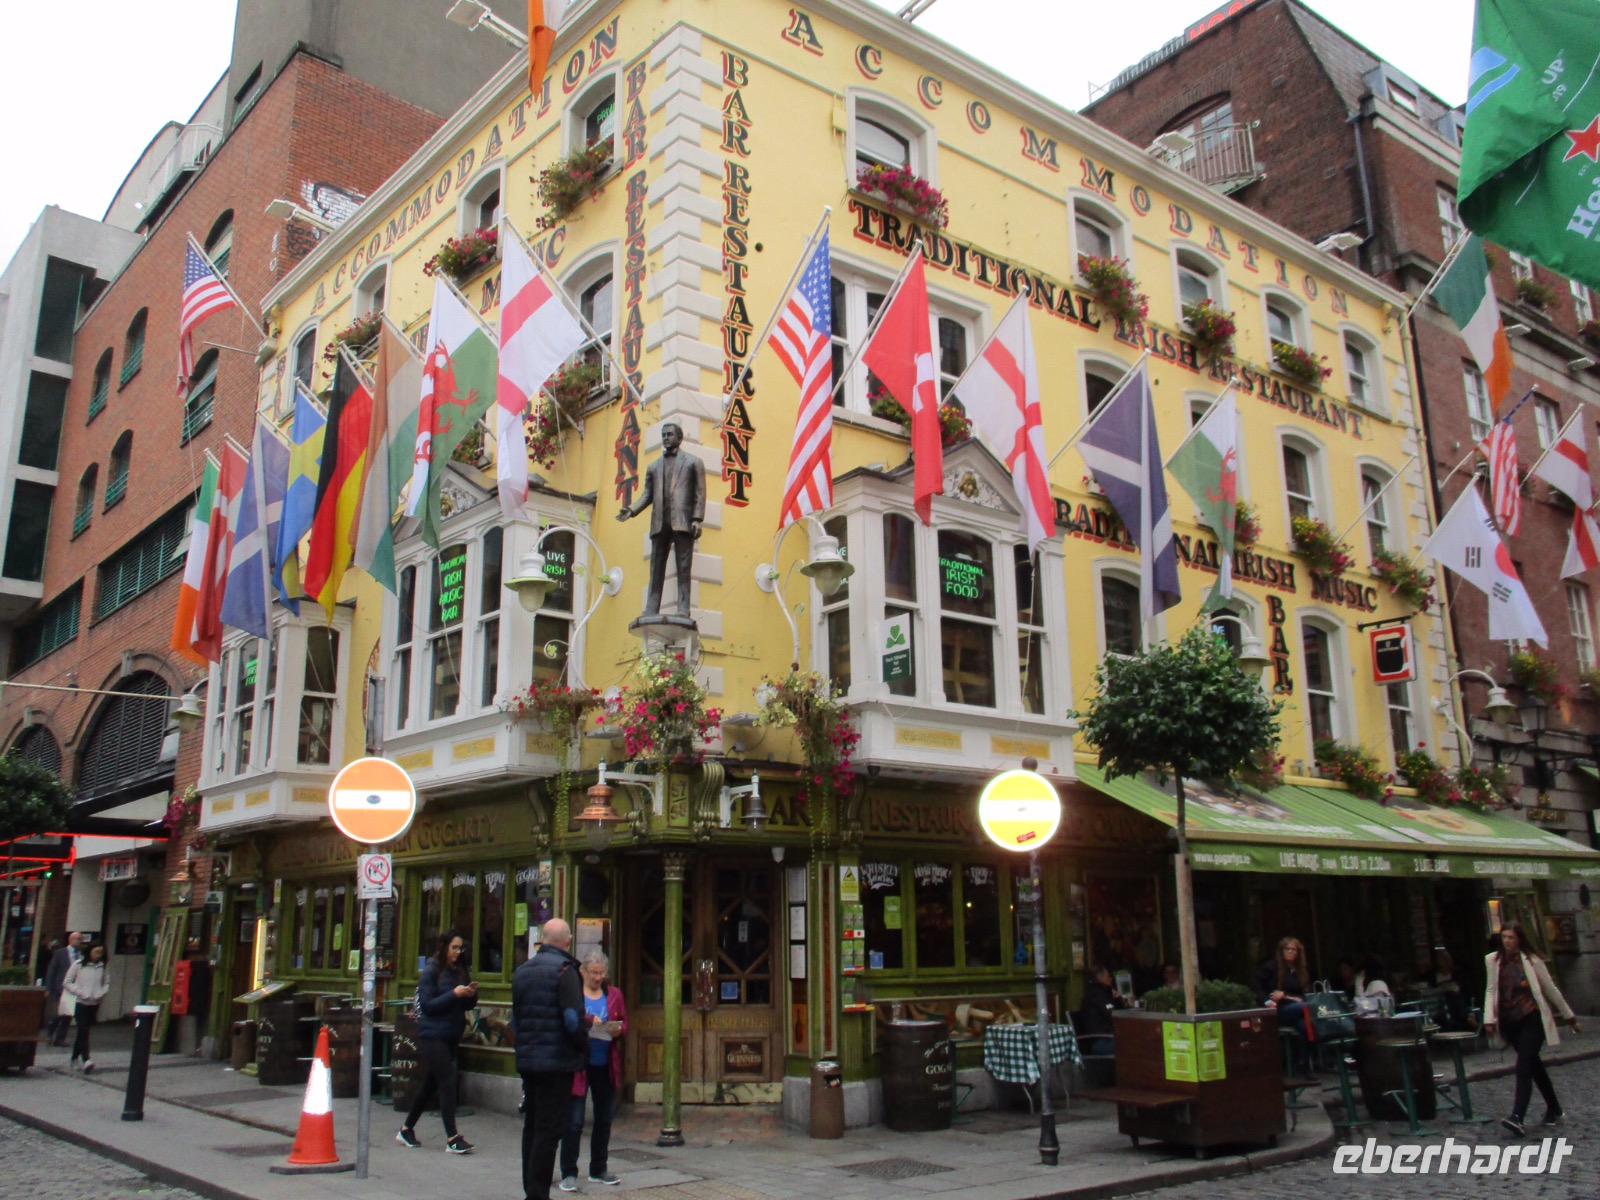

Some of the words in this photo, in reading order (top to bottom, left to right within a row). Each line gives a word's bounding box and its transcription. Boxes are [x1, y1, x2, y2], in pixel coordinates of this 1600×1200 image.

[623, 61, 648, 171] BAR
[719, 50, 753, 158] BAR
[310, 15, 621, 317] ACCOMMODATION
[781, 8, 1348, 318] ACCOMMODATION
[1566, 176, 1600, 239] He
[614, 169, 648, 508] RESTAURANT
[720, 160, 756, 507] RESTAURANT
[849, 199, 1100, 332] TRADITIONAL
[1114, 316, 1200, 374] IRISH
[1208, 355, 1364, 440] RESTAURANT
[547, 551, 566, 563] LIVE
[945, 568, 978, 585] IRISH
[945, 582, 980, 599] FOOD
[1231, 546, 1296, 593] IRISH
[1310, 567, 1378, 613] MUSIC
[1265, 594, 1294, 696] BAR
